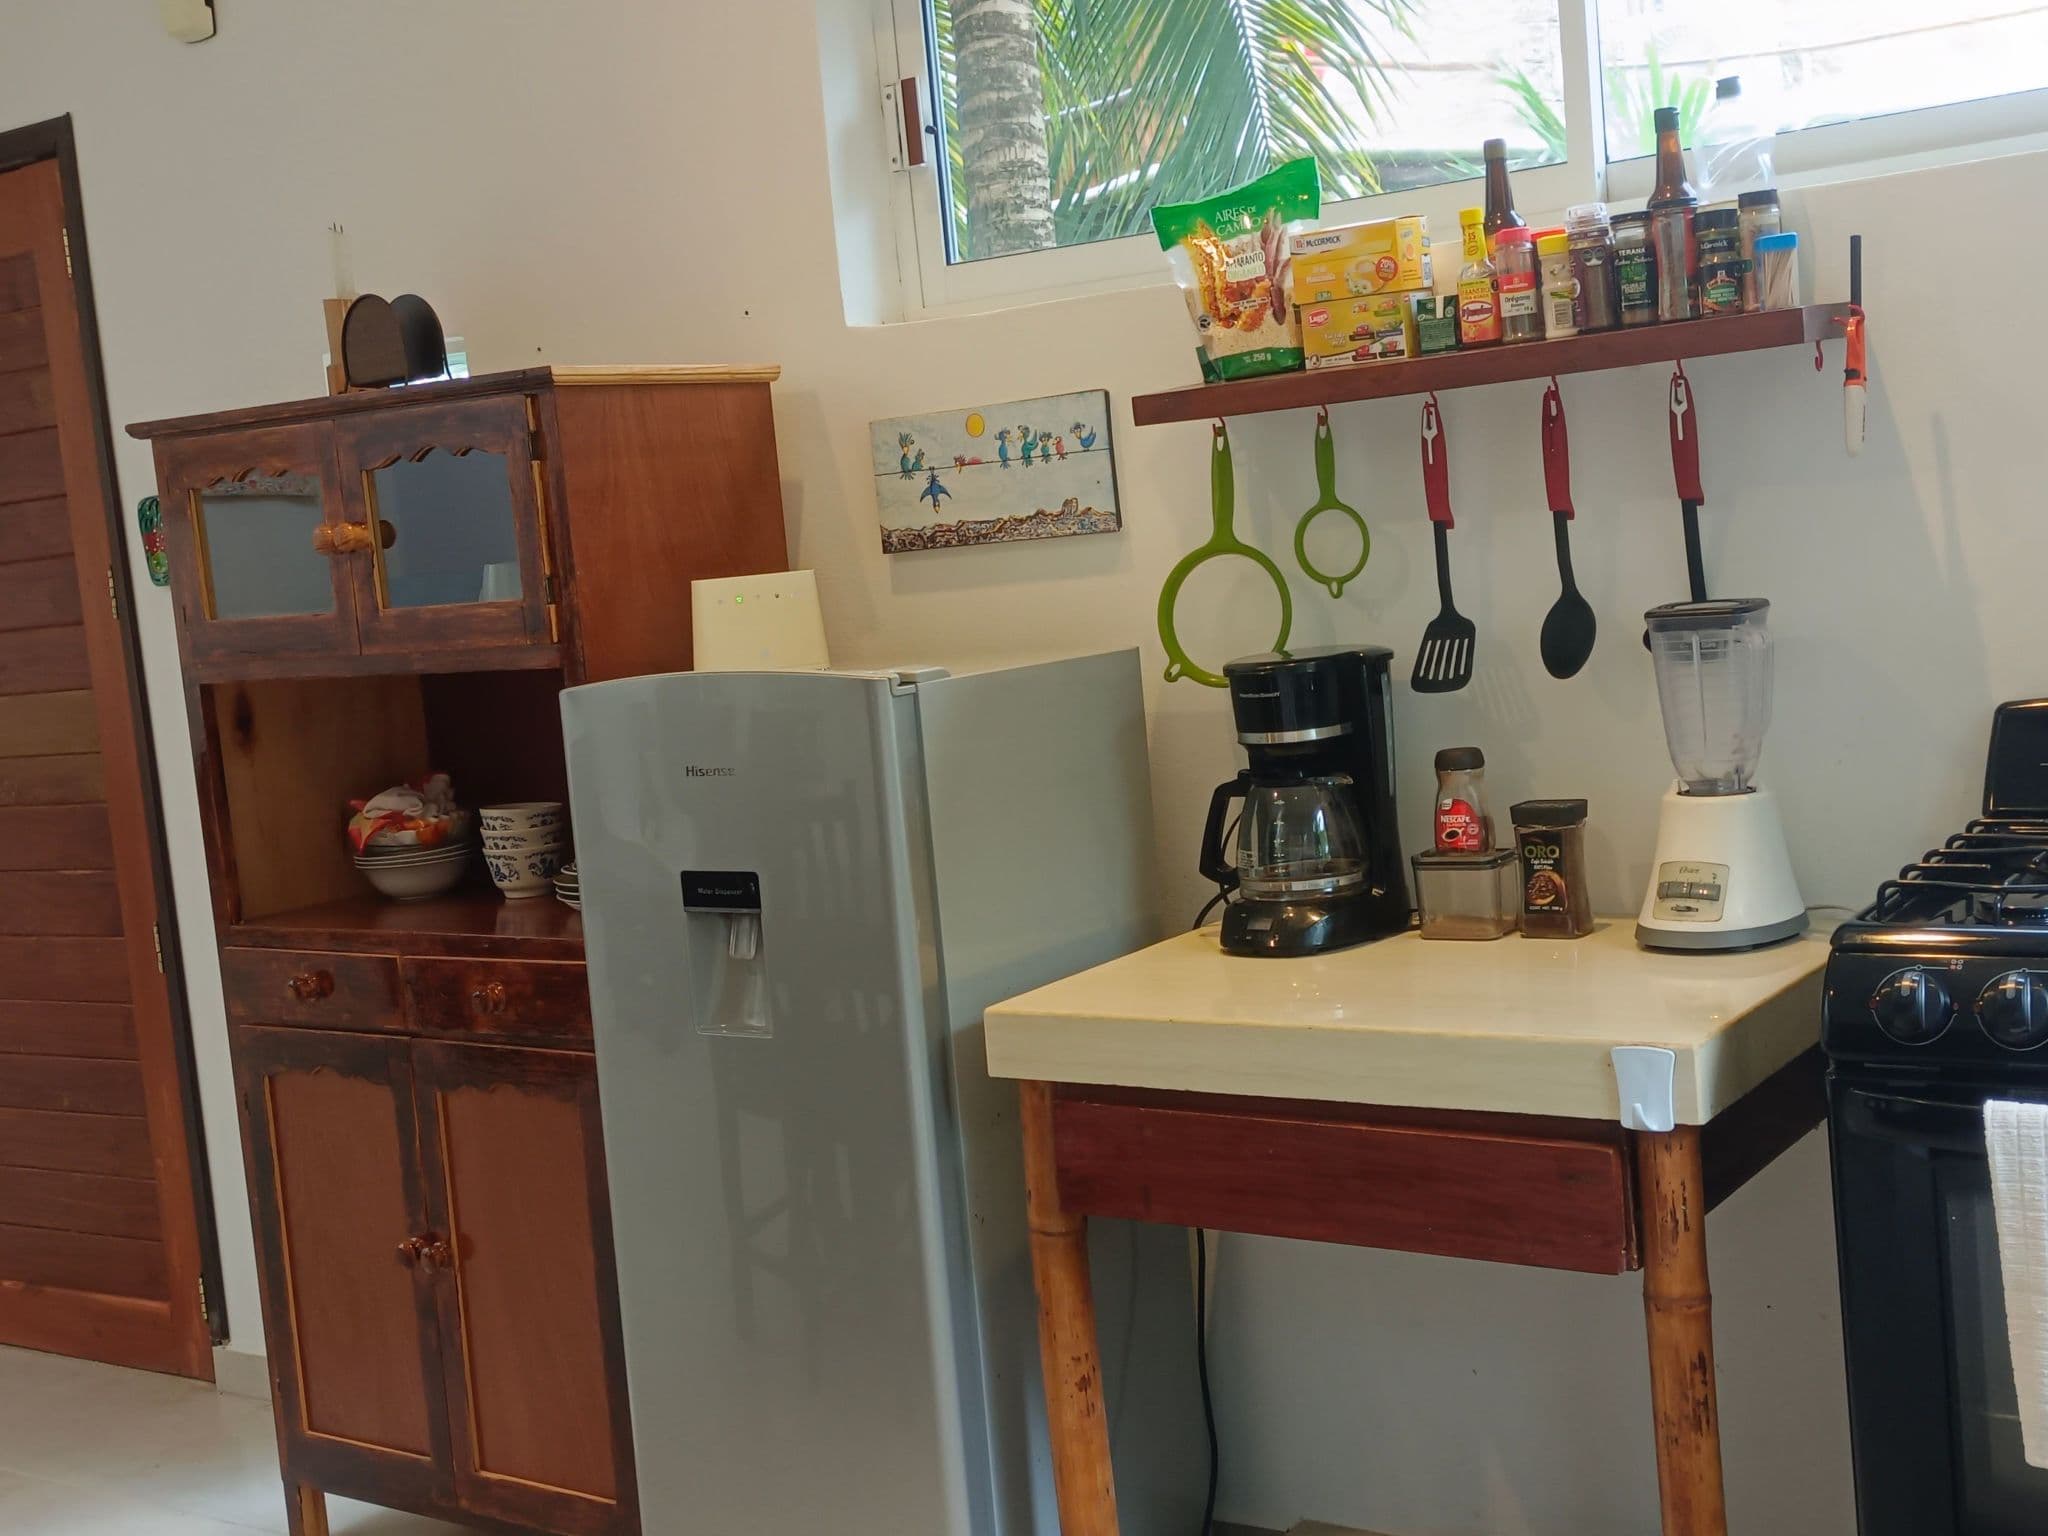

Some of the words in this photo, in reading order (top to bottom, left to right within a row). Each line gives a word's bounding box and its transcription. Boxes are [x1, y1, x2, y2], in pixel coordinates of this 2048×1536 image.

[1215, 205, 1247, 224] AIRES
[1215, 216, 1262, 236] CAMO
[685, 765, 737, 777] Hisense
[1524, 845, 1560, 859] ORO
